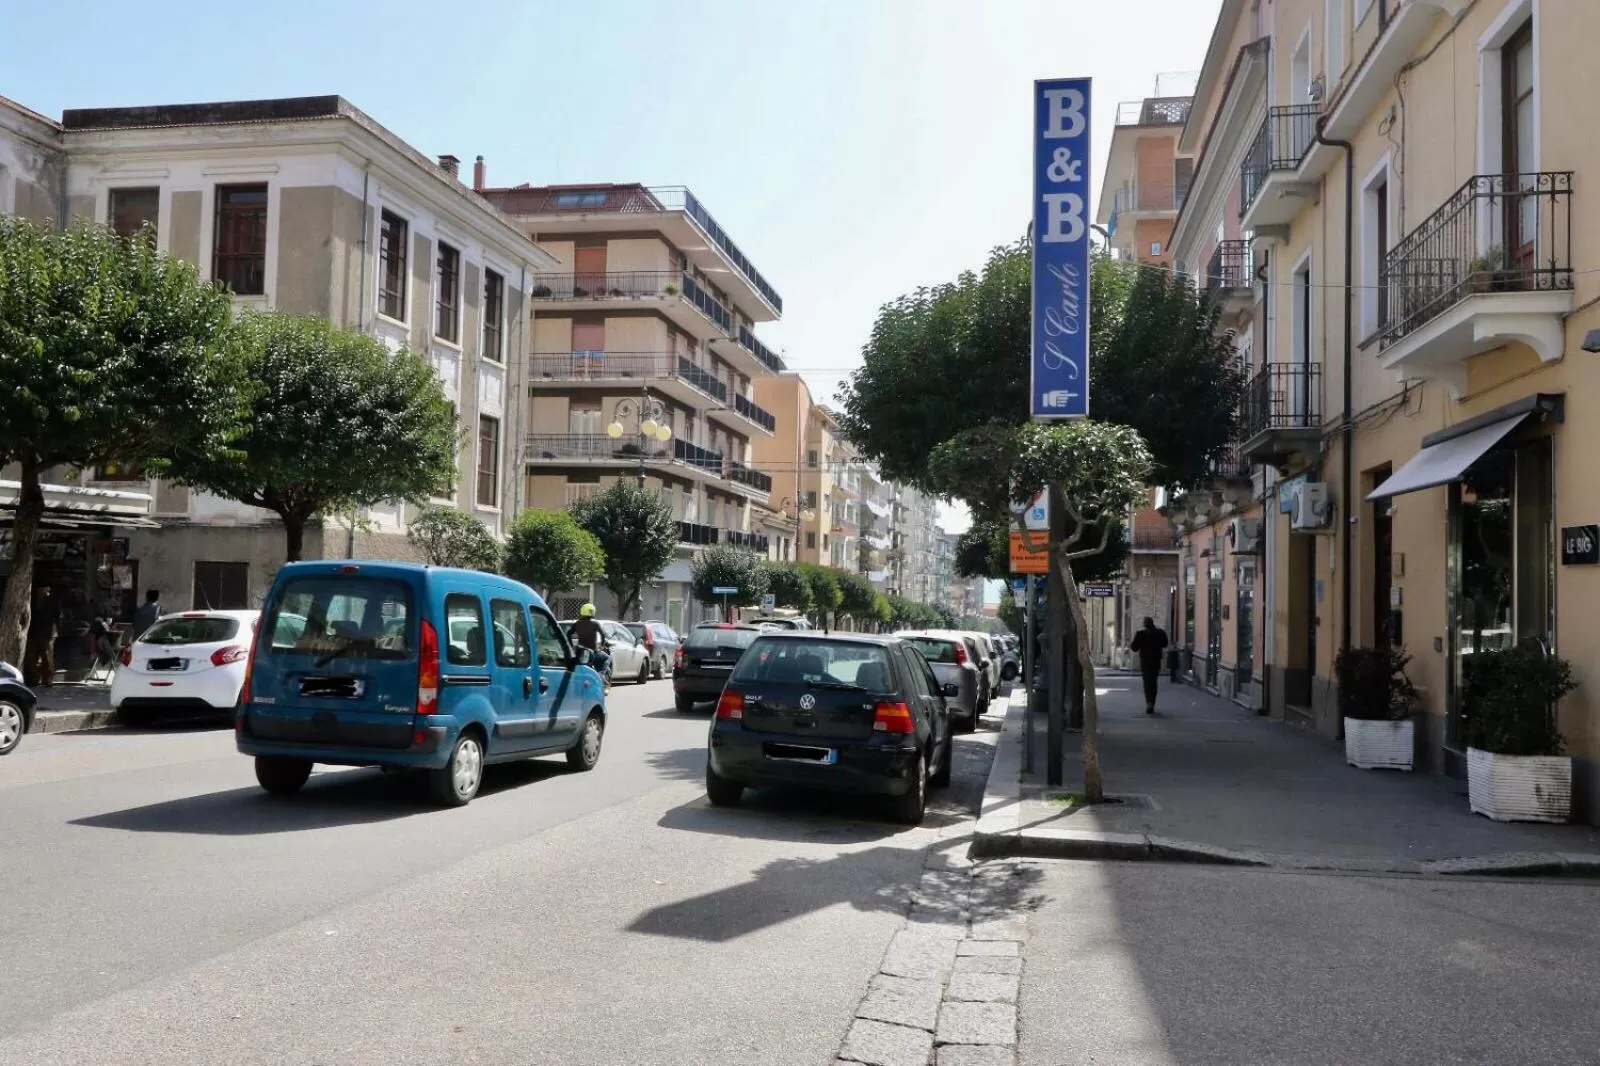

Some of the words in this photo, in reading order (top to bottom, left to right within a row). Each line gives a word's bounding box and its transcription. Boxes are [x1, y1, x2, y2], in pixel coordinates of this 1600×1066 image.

[1043, 262, 1081, 337] Carlo
[1566, 537, 1575, 554] LE
[1576, 536, 1592, 553] BIG
